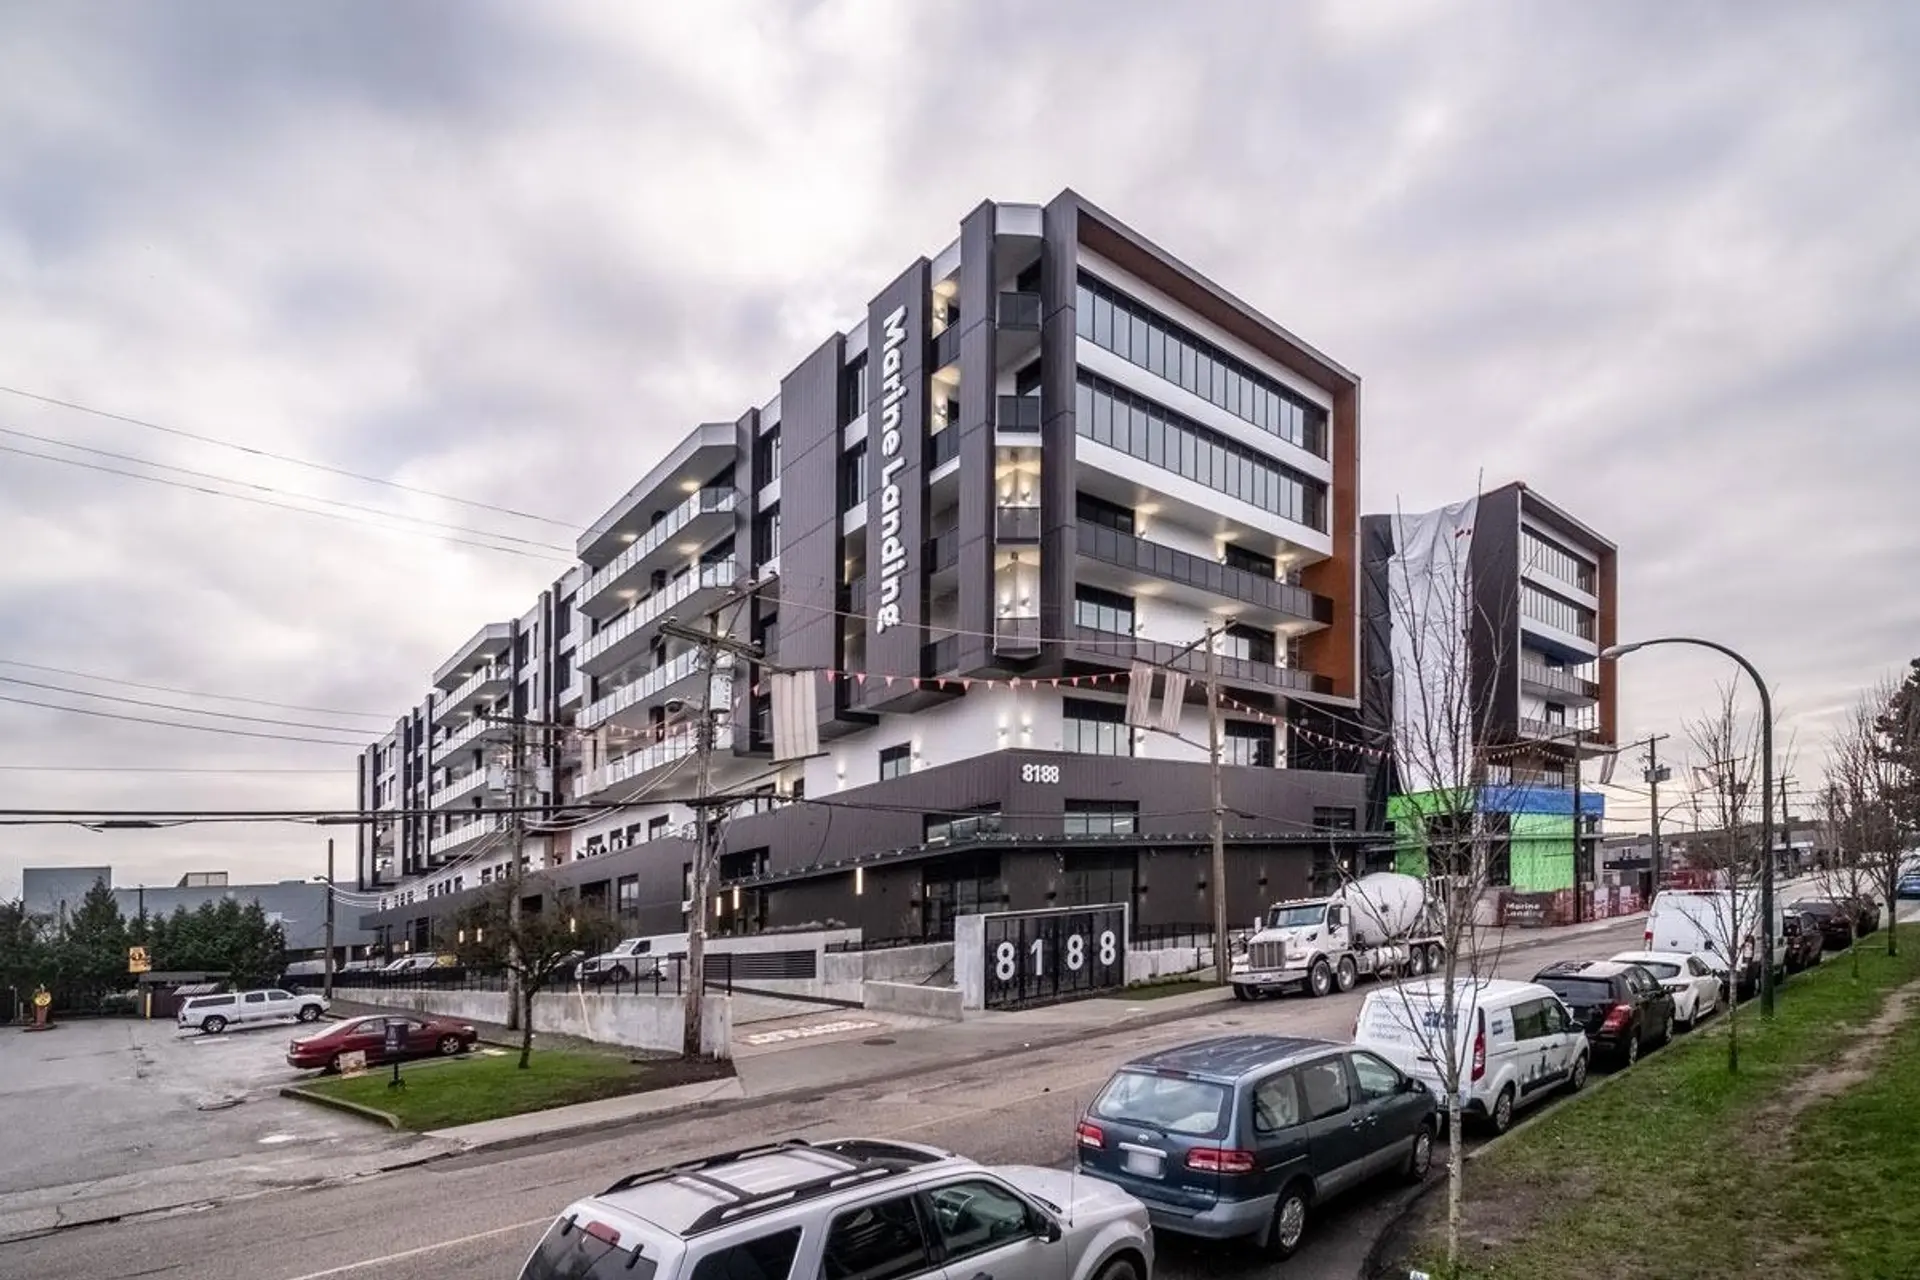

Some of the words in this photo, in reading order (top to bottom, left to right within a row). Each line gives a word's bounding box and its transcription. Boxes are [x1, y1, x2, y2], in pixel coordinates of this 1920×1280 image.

[882, 305, 908, 457] Marine
[877, 458, 908, 634] Landing
[1022, 763, 1060, 784] 8188
